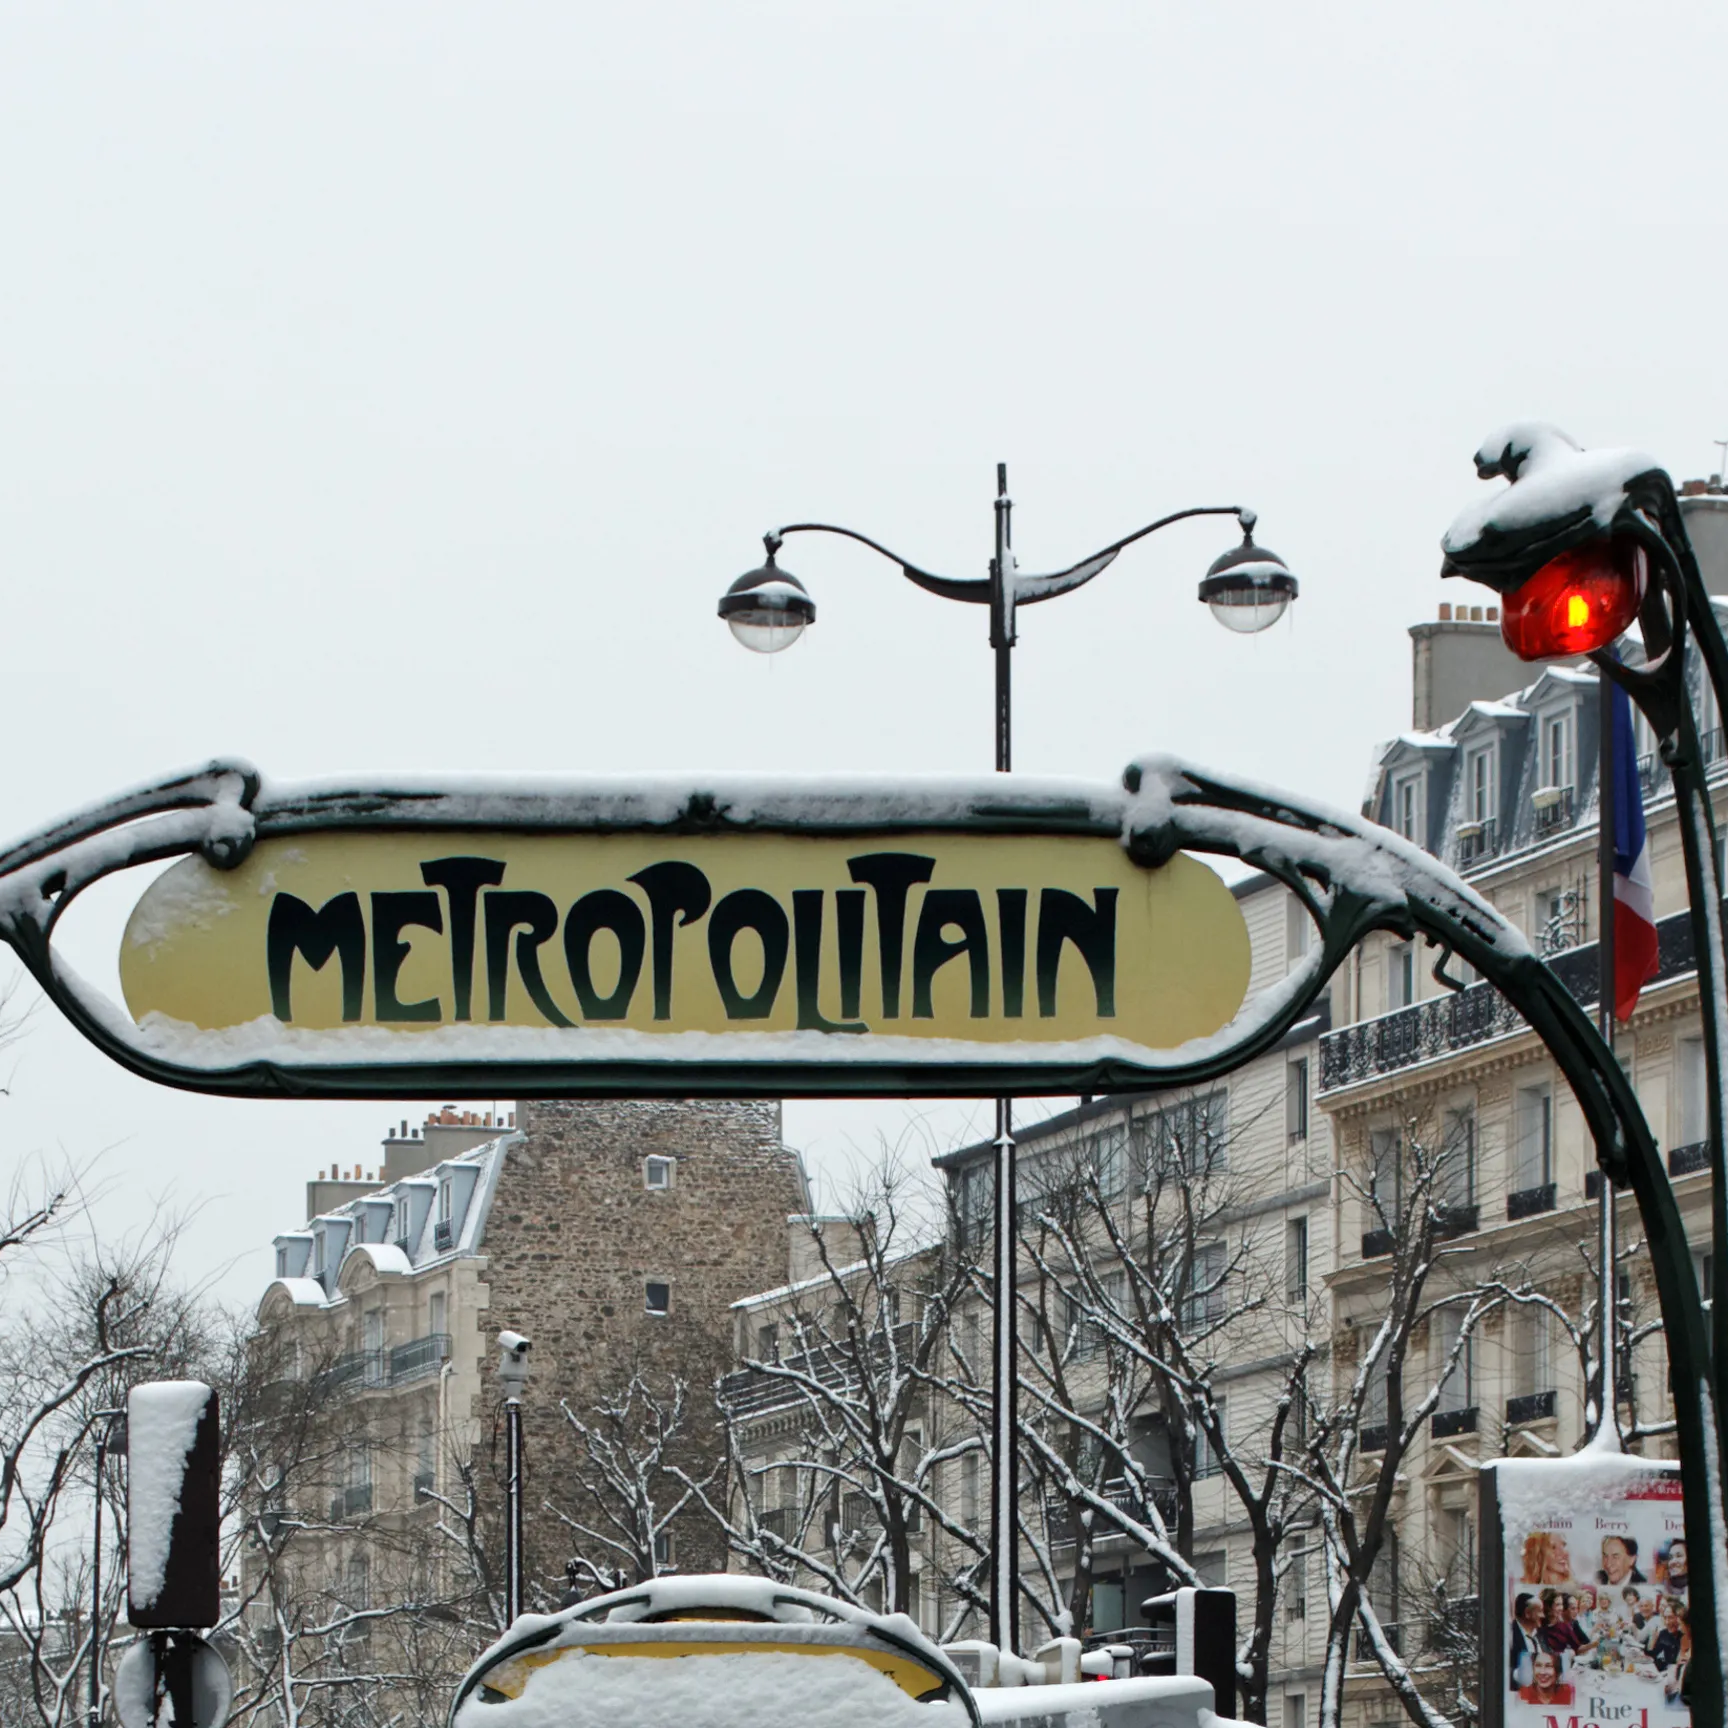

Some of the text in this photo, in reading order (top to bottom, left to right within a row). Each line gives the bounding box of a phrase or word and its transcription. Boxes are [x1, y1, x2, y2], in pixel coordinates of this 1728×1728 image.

[265, 852, 1120, 1034] METROPOLITAIN
[1595, 1517, 1630, 1532] Berry
[1588, 1697, 1632, 1720] Rue
